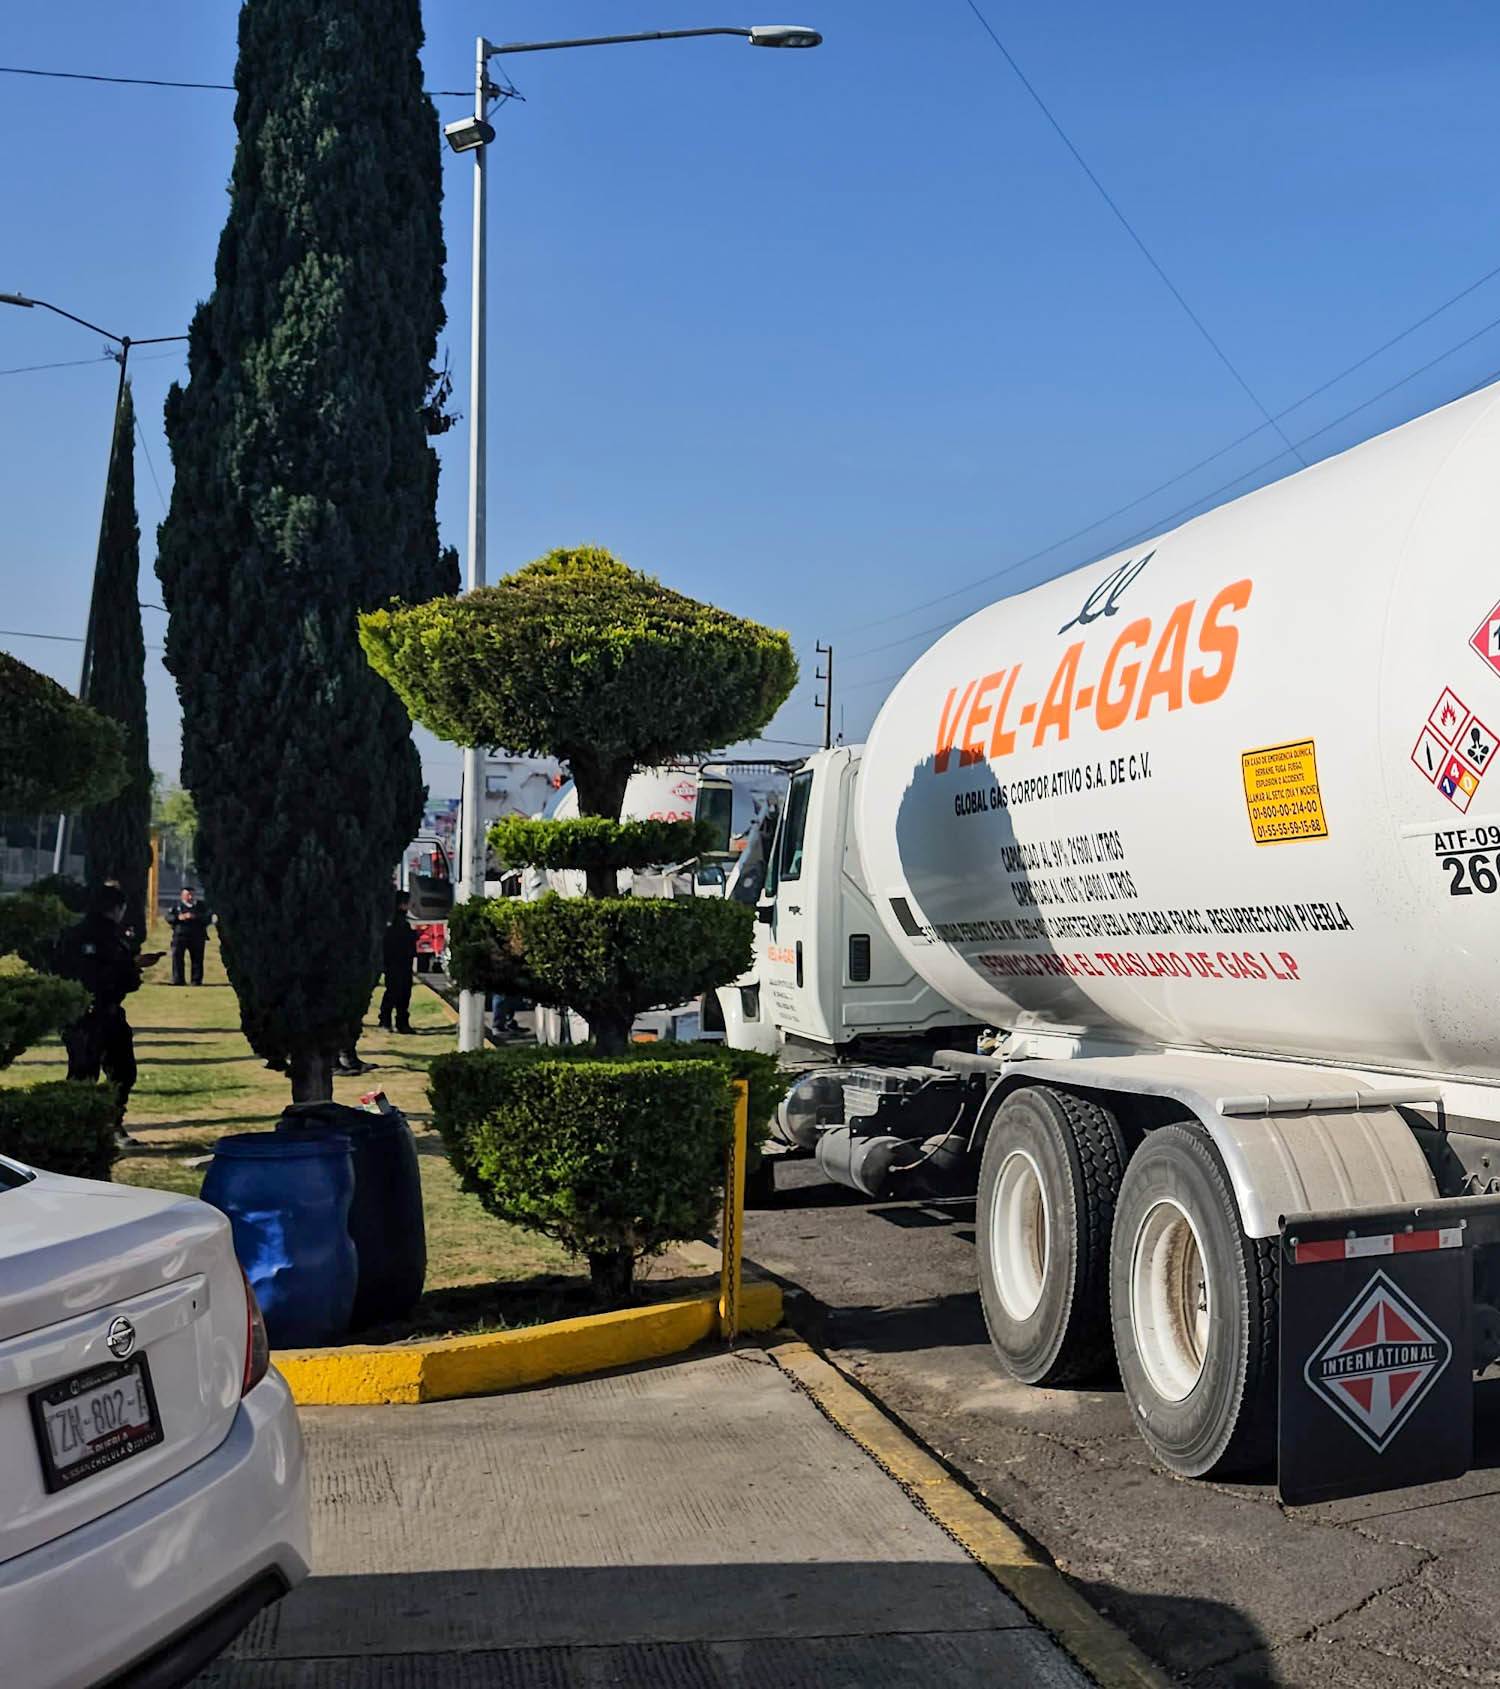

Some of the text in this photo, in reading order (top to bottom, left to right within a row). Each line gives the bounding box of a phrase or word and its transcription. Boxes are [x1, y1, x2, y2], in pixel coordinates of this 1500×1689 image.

[934, 578, 1253, 774] VEL-A-GAS
[1262, 756, 1268, 765] DE
[1450, 763, 1460, 778] 4
[954, 789, 988, 816] GLOBAL
[990, 785, 1008, 810] GAS
[1085, 763, 1106, 790] S.A.
[1110, 757, 1125, 785] DE
[1129, 752, 1152, 781] C.V.
[1442, 778, 1451, 794] 1
[1463, 776, 1473, 791] 0
[1252, 799, 1317, 820] 01-800-00-214-00
[1257, 819, 1322, 838] 01-55-55-59-15-88
[1000, 843, 1040, 873] CAPACIDAD
[1040, 841, 1052, 869] AL
[1091, 830, 1124, 862] LITROS
[1011, 879, 1053, 907] CAPACIDAD
[1049, 878, 1064, 904] AL
[1102, 870, 1138, 901] LITROS
[1127, 911, 1174, 936] ORIZABA
[1168, 909, 1212, 934] FRACC.
[1206, 904, 1301, 934] RESURRECCION
[1294, 902, 1354, 932] PUEBLA
[978, 952, 1301, 980] SERVICIO PARA EL TRASLADO DE GAS L.P
[1322, 1345, 1436, 1376] INTERNATIONAL
